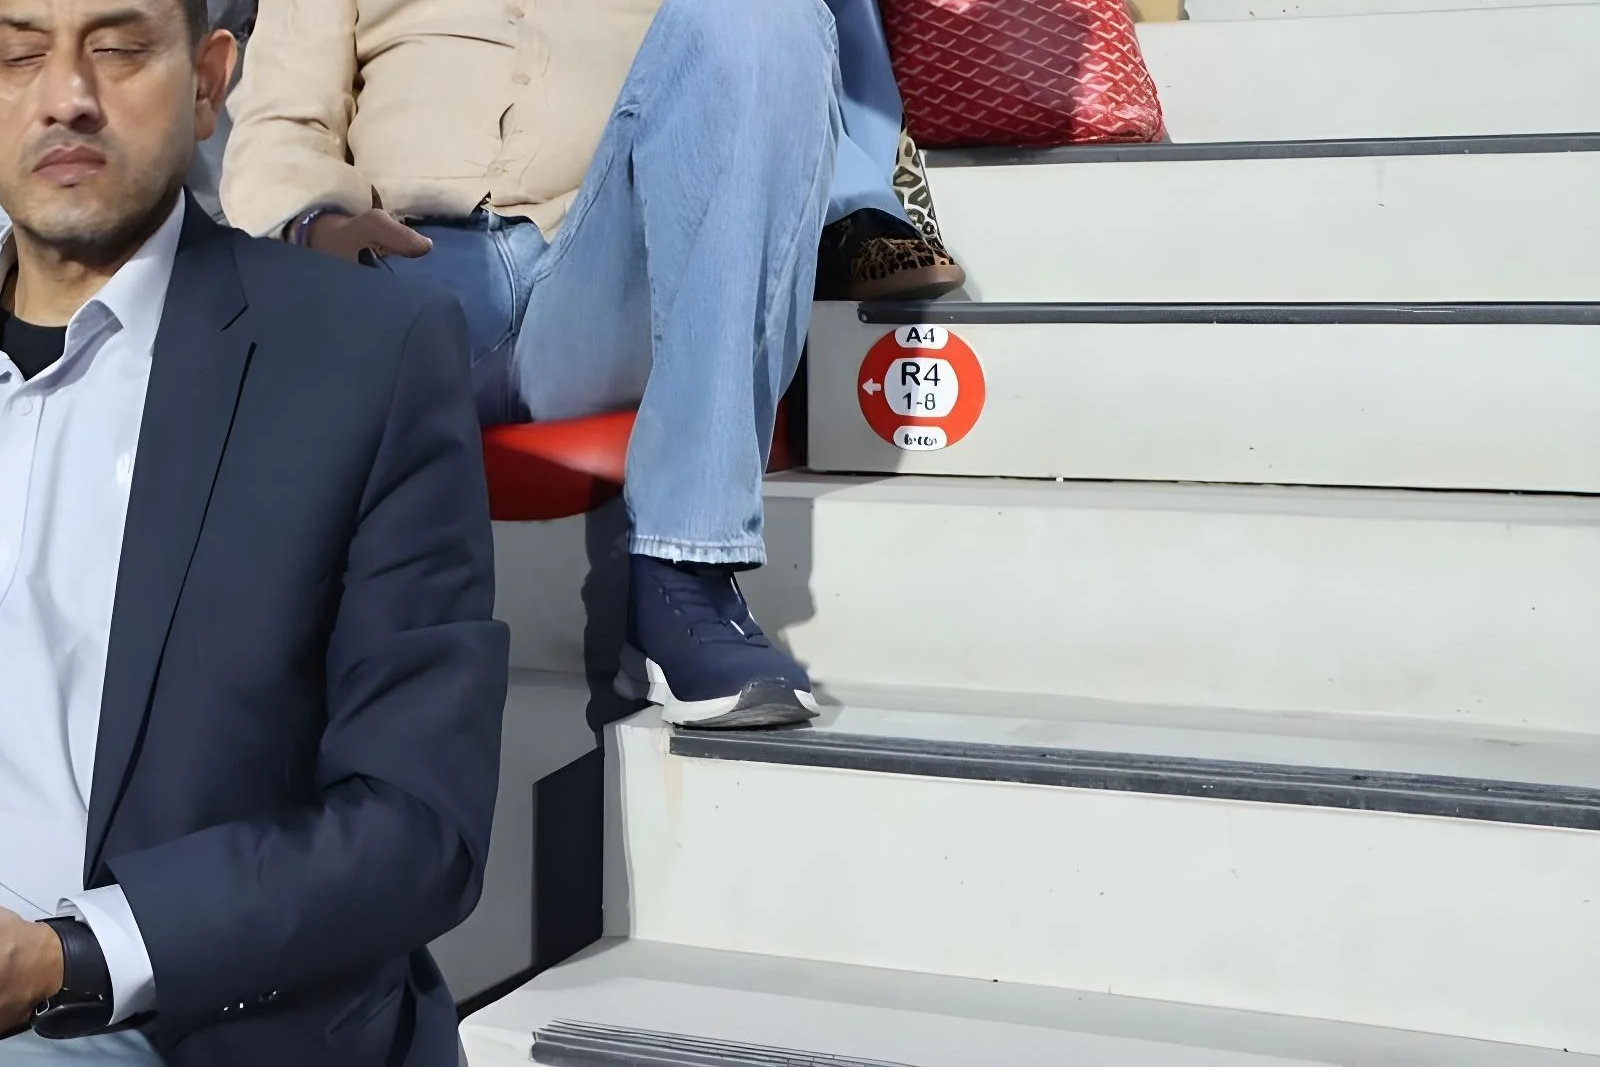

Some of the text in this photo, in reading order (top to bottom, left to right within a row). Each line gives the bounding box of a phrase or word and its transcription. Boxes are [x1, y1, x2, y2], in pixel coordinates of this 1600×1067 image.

[906, 326, 935, 343] A4
[901, 361, 941, 386] R4
[902, 392, 936, 410] 1-8
